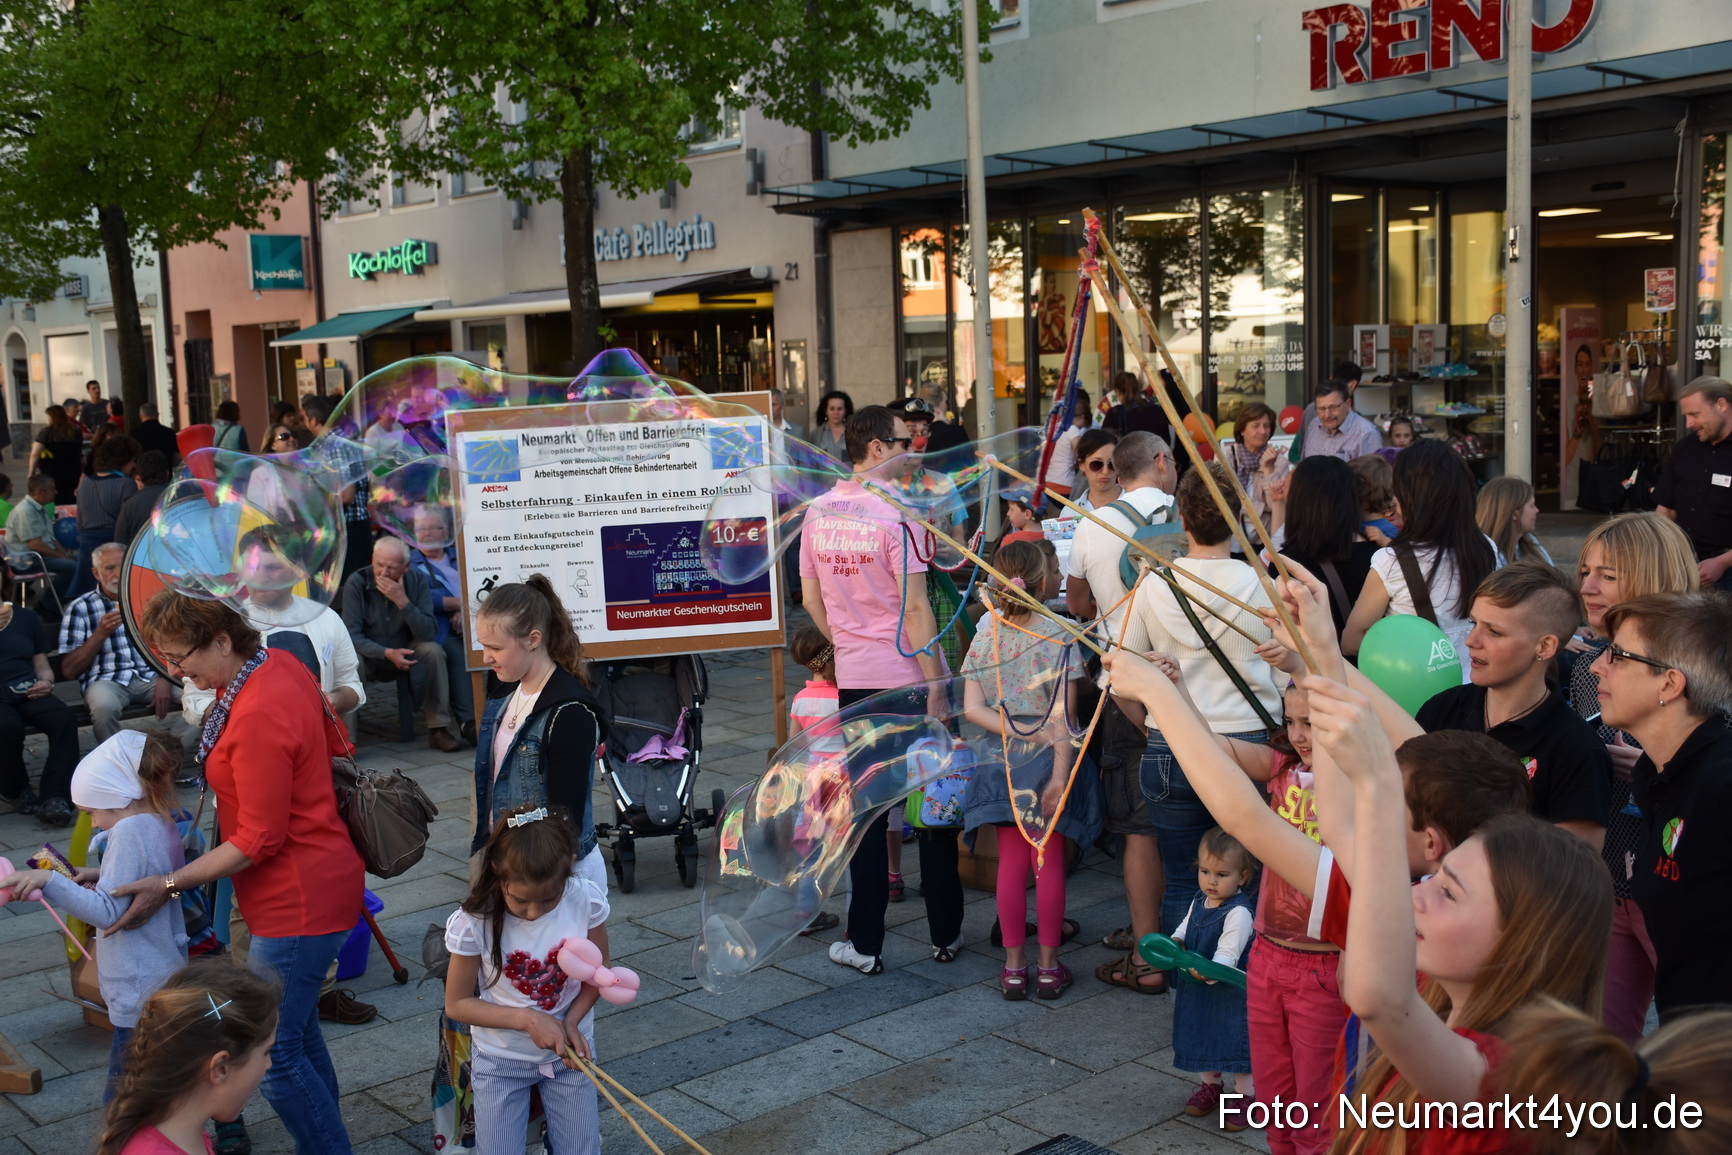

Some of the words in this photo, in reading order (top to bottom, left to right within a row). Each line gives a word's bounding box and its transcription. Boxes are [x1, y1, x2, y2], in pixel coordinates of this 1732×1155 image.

[1302, 0, 1597, 91] RENO
[594, 226, 631, 261] Cafe
[632, 214, 715, 262] Pellegrin
[348, 238, 428, 281] Kochlöffel
[255, 269, 303, 281] Kochlöffel
[785, 263, 799, 281] 21
[1696, 324, 1723, 337] WIR
[1208, 355, 1235, 365] MO-FR
[1241, 354, 1258, 363] 9.00
[1265, 354, 1286, 363] 19.00
[1695, 350, 1712, 360] SA
[1208, 365, 1219, 374] SA
[1241, 364, 1258, 373] 9.00
[522, 431, 577, 447] Neumarkt
[586, 429, 616, 443] Offen
[619, 427, 639, 441] und
[642, 423, 706, 440] Barrierefrei
[534, 466, 607, 479] Arbeitsgemeinschaft
[609, 463, 632, 474] Offene
[634, 461, 698, 473] Behindertenarbeit
[481, 496, 574, 510] Selbsterfahrung
[584, 491, 643, 503] Einkaufen
[647, 490, 658, 499] in
[662, 488, 697, 498] einem
[701, 484, 753, 496] Rollstuhl
[524, 512, 560, 522] (Erleben
[562, 511, 575, 519] sie
[578, 508, 619, 518] Barrieren
[621, 507, 638, 516] und
[640, 503, 713, 515] Barrierefreiheit!)
[475, 535, 490, 543] Mit
[492, 534, 511, 542] dem
[514, 529, 595, 541] Einkaufsgutschein
[487, 546, 501, 554] auf
[504, 541, 584, 553] Entdeckungsreise!
[626, 548, 656, 557] Neumarkt
[616, 607, 671, 620] Neumarkter
[674, 601, 763, 617] Geschenkgutschein
